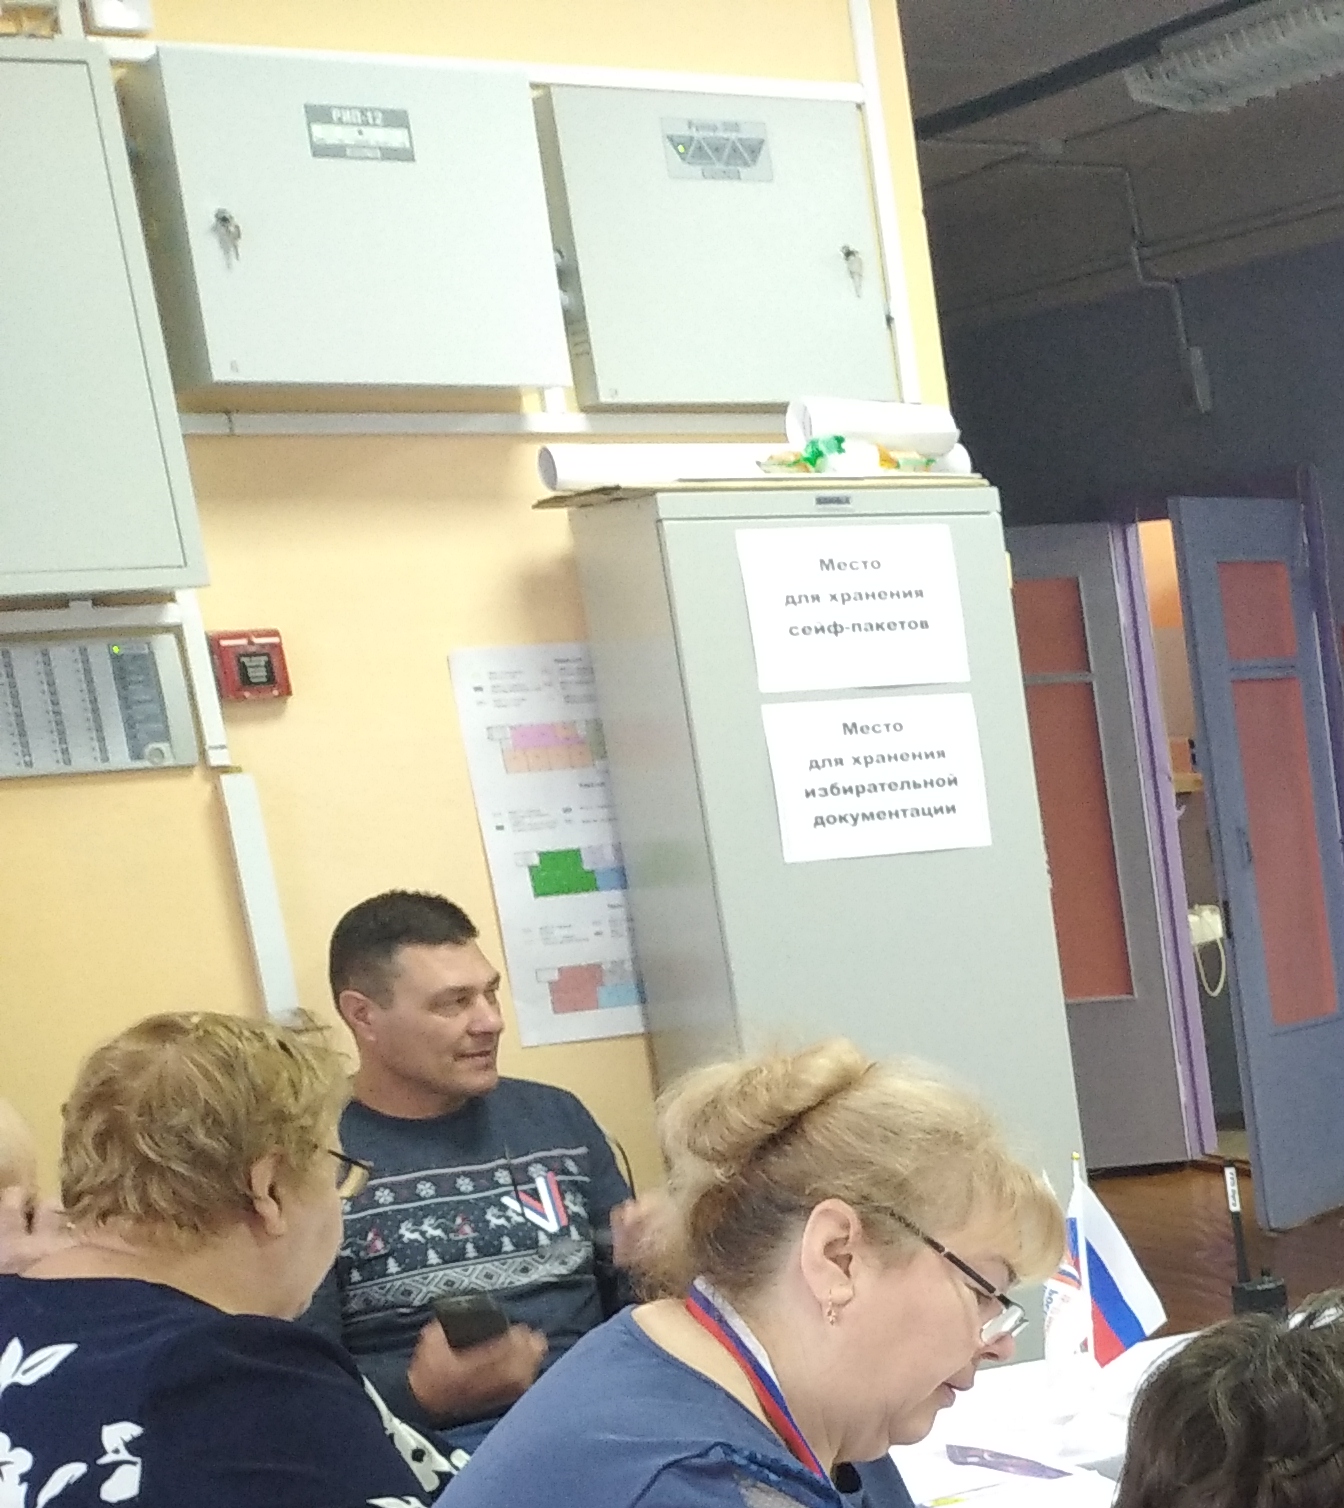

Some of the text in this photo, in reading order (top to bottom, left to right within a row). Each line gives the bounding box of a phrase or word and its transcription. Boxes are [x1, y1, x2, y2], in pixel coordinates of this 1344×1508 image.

[818, 557, 882, 572] Место
[784, 588, 925, 607] для хранения
[842, 721, 904, 736] Место
[808, 749, 947, 772] для хранения
[804, 773, 959, 799] избирательной
[813, 803, 957, 829] документации
